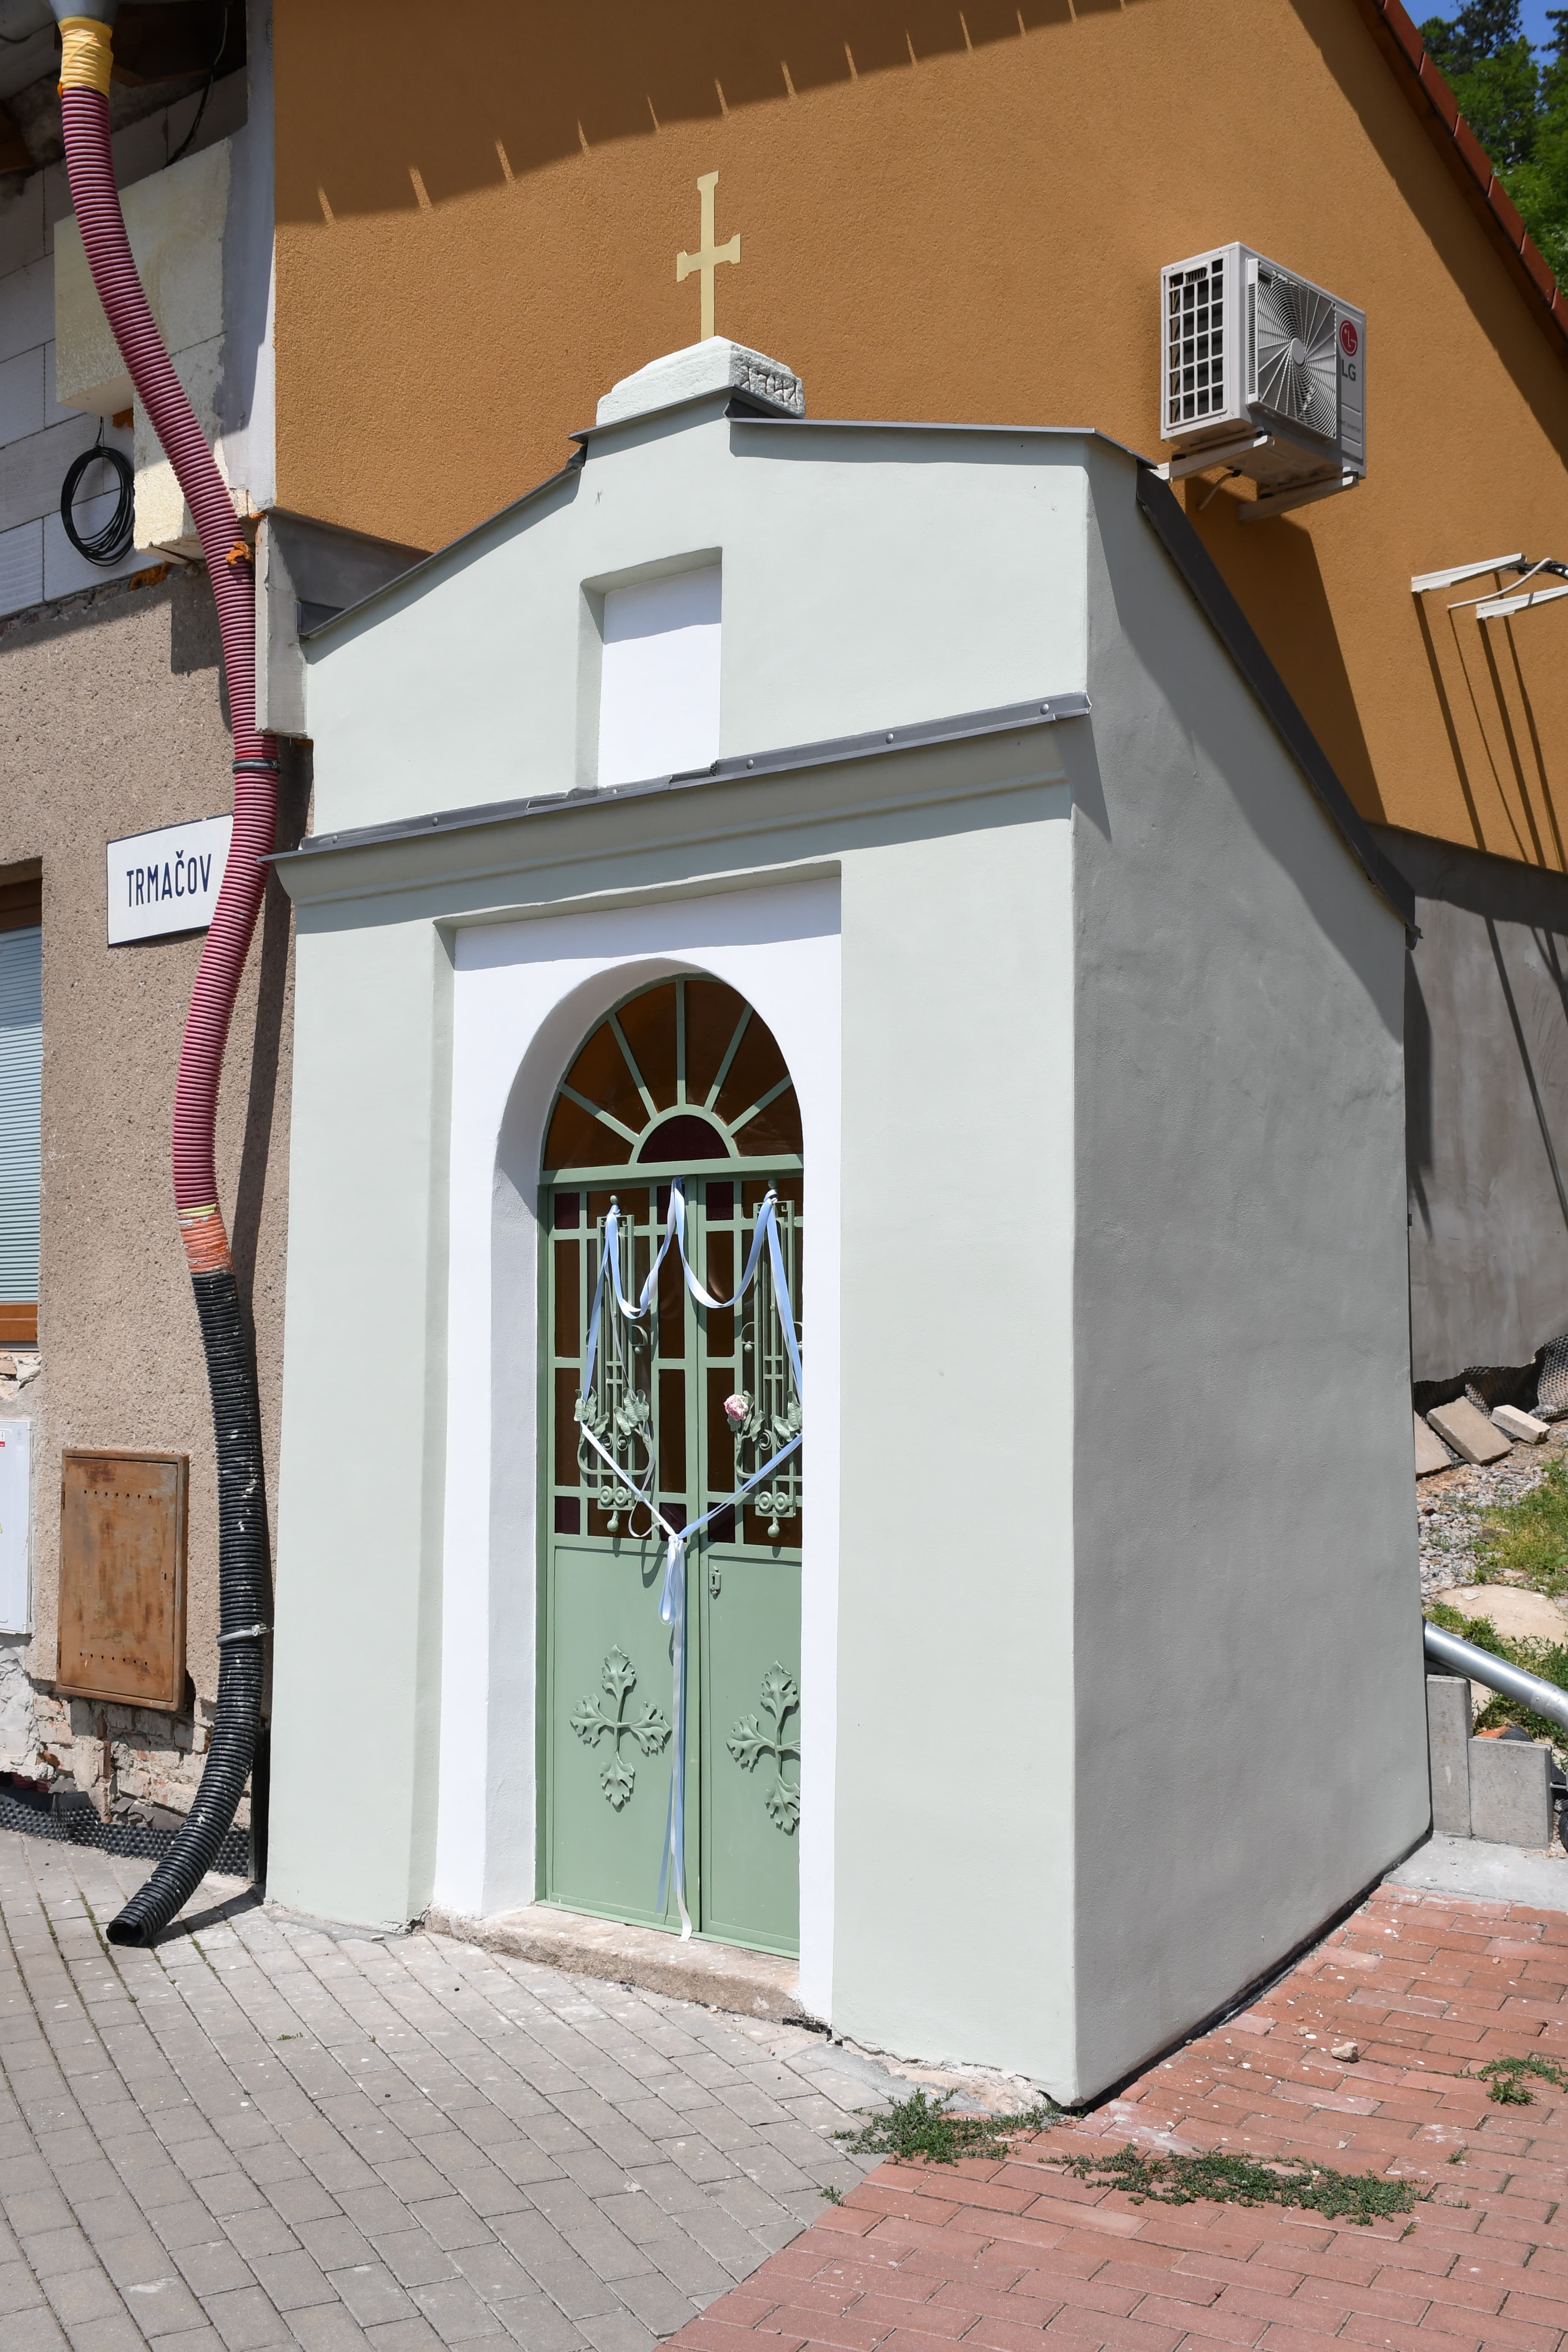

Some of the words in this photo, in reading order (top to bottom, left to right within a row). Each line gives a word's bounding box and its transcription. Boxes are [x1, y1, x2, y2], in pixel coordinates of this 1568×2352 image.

[740, 365, 798, 406] 1741
[1342, 359, 1356, 382] LG
[126, 849, 212, 907] TRMAČOV
